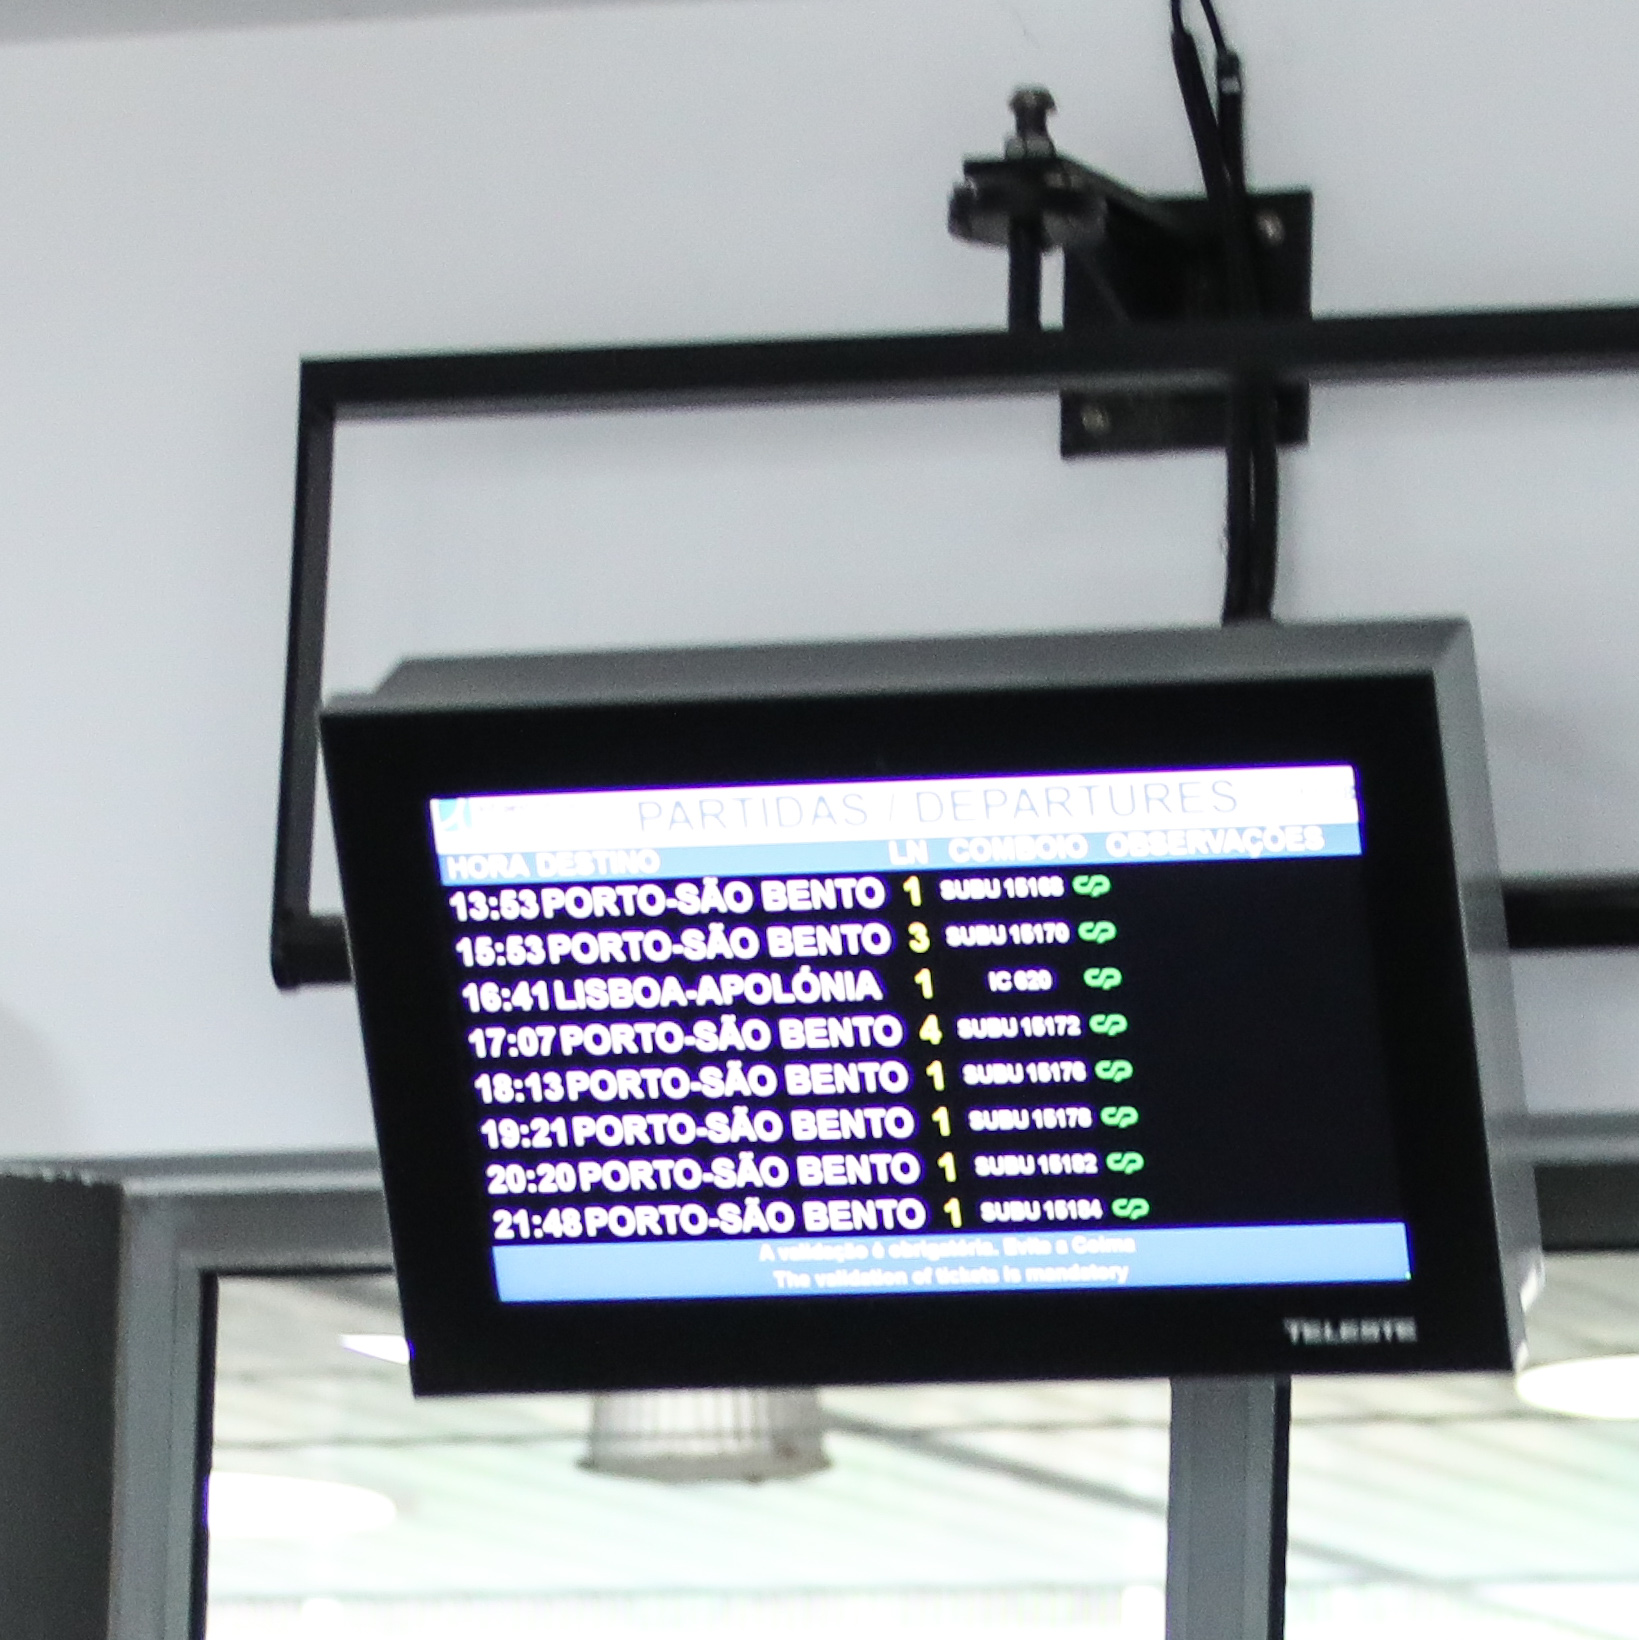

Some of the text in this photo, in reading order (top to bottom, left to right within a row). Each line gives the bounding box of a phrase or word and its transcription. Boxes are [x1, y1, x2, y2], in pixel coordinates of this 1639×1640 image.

[638, 794, 868, 832] PARTIDAS
[916, 780, 1238, 823] DEPARTURES
[447, 825, 1325, 881] HORA DESTINO LN COMBOIO OBSERVAÇÕES
[450, 890, 540, 921] 13:53
[542, 877, 754, 919] PORTO-SÃO
[761, 876, 886, 911] BENTO
[902, 876, 922, 907] 1
[456, 935, 546, 966] 15:53
[548, 923, 760, 965] PORTO-SÃO
[767, 922, 892, 957] BENTO
[908, 922, 928, 953] 3
[462, 980, 552, 1012] 16:41
[553, 965, 884, 1012] LISBOA-APOLÓNIA
[914, 968, 933, 999] 1
[987, 970, 1012, 992] IC
[468, 1025, 558, 1057] 17:07
[560, 1014, 772, 1056] PORTO-SÃO
[779, 1014, 904, 1048] BENTO
[918, 1014, 943, 1045] 4
[474, 1071, 564, 1103] 18:13
[566, 1060, 777, 1101] PORTO-SÃO
[784, 1060, 909, 1094] BENTO
[926, 1060, 945, 1090] 1
[480, 1116, 570, 1148] 19:21
[572, 1106, 783, 1147] PORTO-SÃO
[790, 1106, 915, 1140] BENTO
[932, 1106, 951, 1136] 1
[486, 1161, 576, 1194] 20:20
[578, 1151, 789, 1192] PORTO-SÃO
[796, 1152, 921, 1185] BENTO
[938, 1152, 956, 1182] 1
[492, 1206, 582, 1239] 21:48
[584, 1197, 795, 1238] PORTO-SÃO
[802, 1198, 927, 1231] BENTO
[944, 1198, 962, 1228] 1
[759, 1243, 775, 1262] A
[774, 1269, 811, 1289] The
[814, 1267, 908, 1288] validation
[912, 1266, 932, 1286] of
[1025, 1262, 1129, 1285] mandatory
